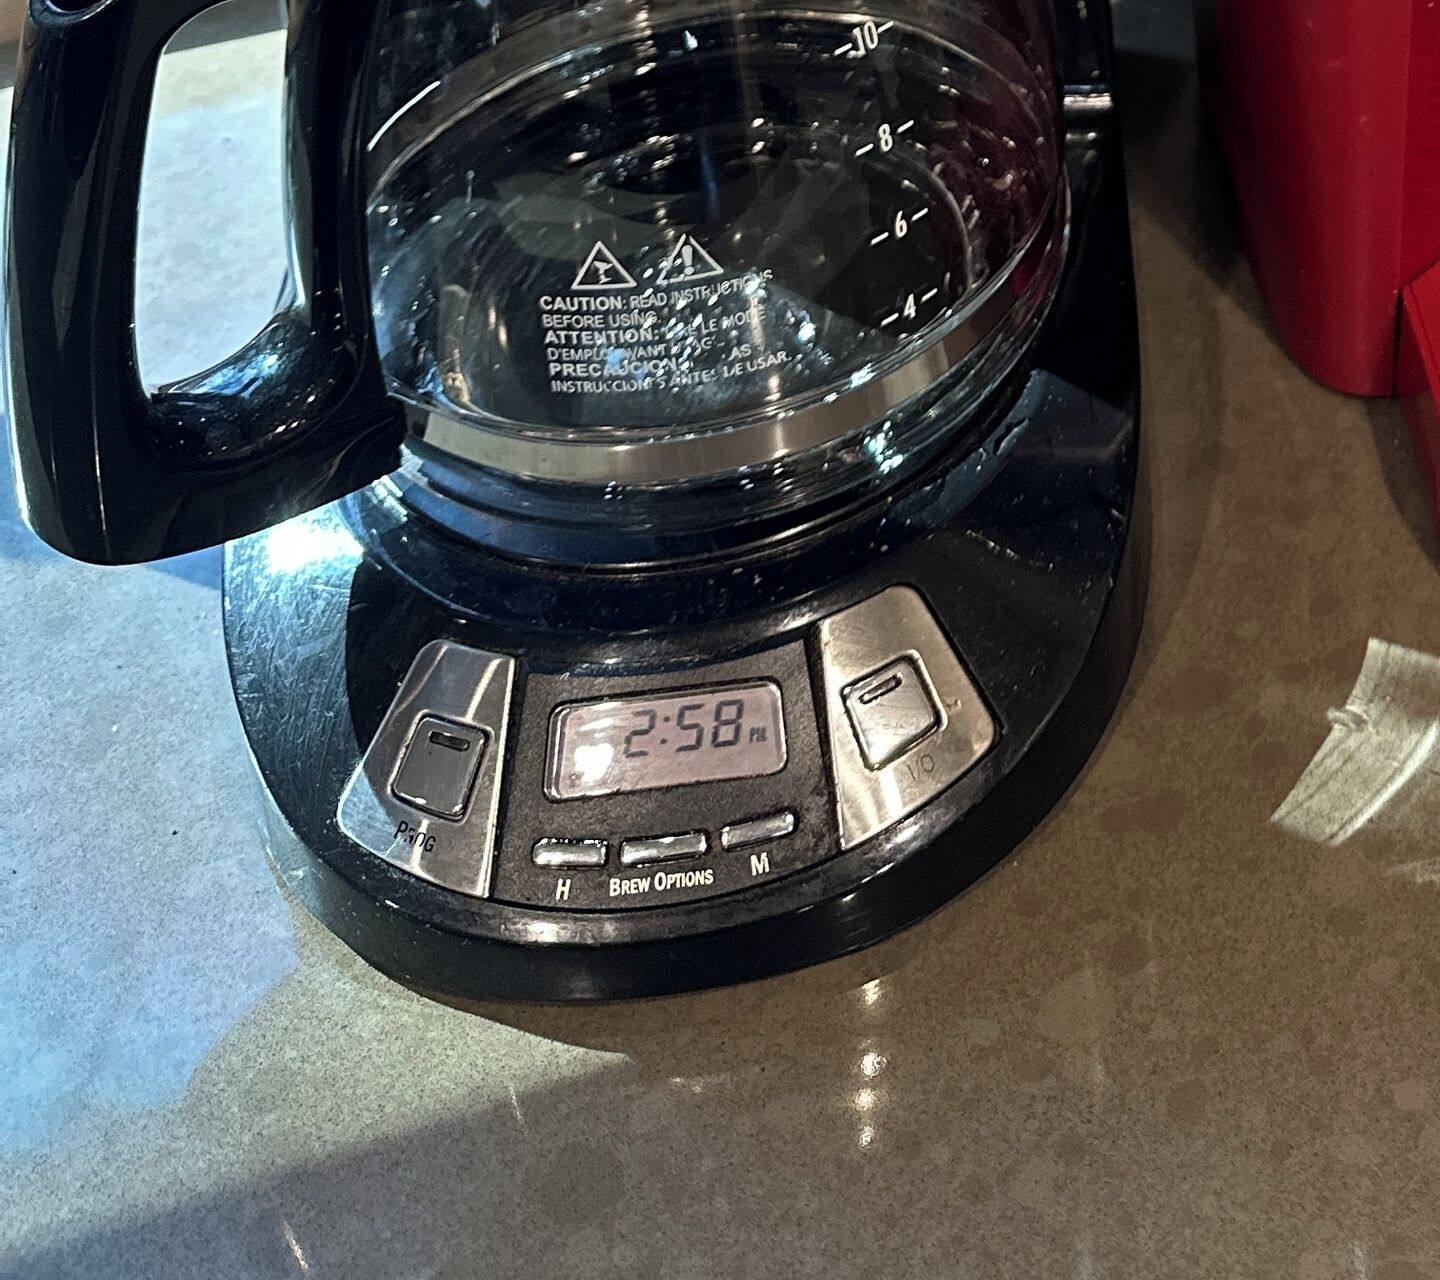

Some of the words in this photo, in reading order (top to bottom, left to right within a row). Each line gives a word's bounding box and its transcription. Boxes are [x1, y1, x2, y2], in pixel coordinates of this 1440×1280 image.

[851, 20, 880, 58] 10
[878, 123, 894, 152] 8
[895, 210, 908, 238] 6
[539, 294, 628, 312] CAUTION:
[629, 291, 668, 310] READ
[670, 269, 774, 304] INSTRUCTIS
[902, 293, 917, 320] 4
[541, 313, 605, 330] BEFORE
[543, 328, 660, 346] ATTENTION:
[546, 346, 623, 362] D'EMPLO
[622, 698, 745, 759] 2:58
[750, 851, 770, 877] M
[554, 878, 571, 901] H
[609, 876, 650, 897] BREW
[654, 869, 715, 893] OPTIONS
